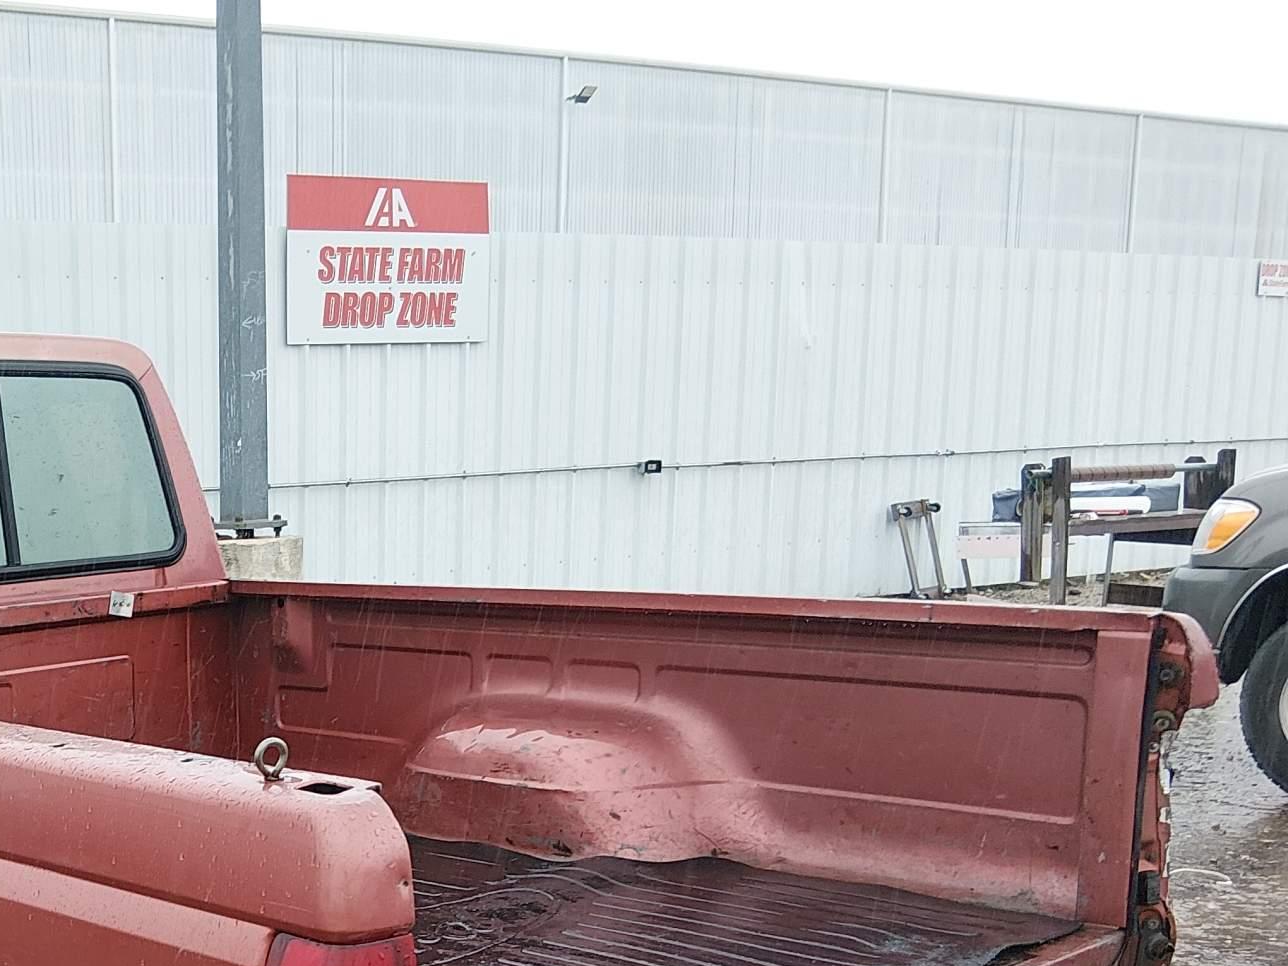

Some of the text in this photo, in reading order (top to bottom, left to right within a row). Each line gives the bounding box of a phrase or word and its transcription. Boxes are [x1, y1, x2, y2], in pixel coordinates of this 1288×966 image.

[317, 245, 466, 285] STATE FARM
[321, 291, 458, 329] DROP ZONE
